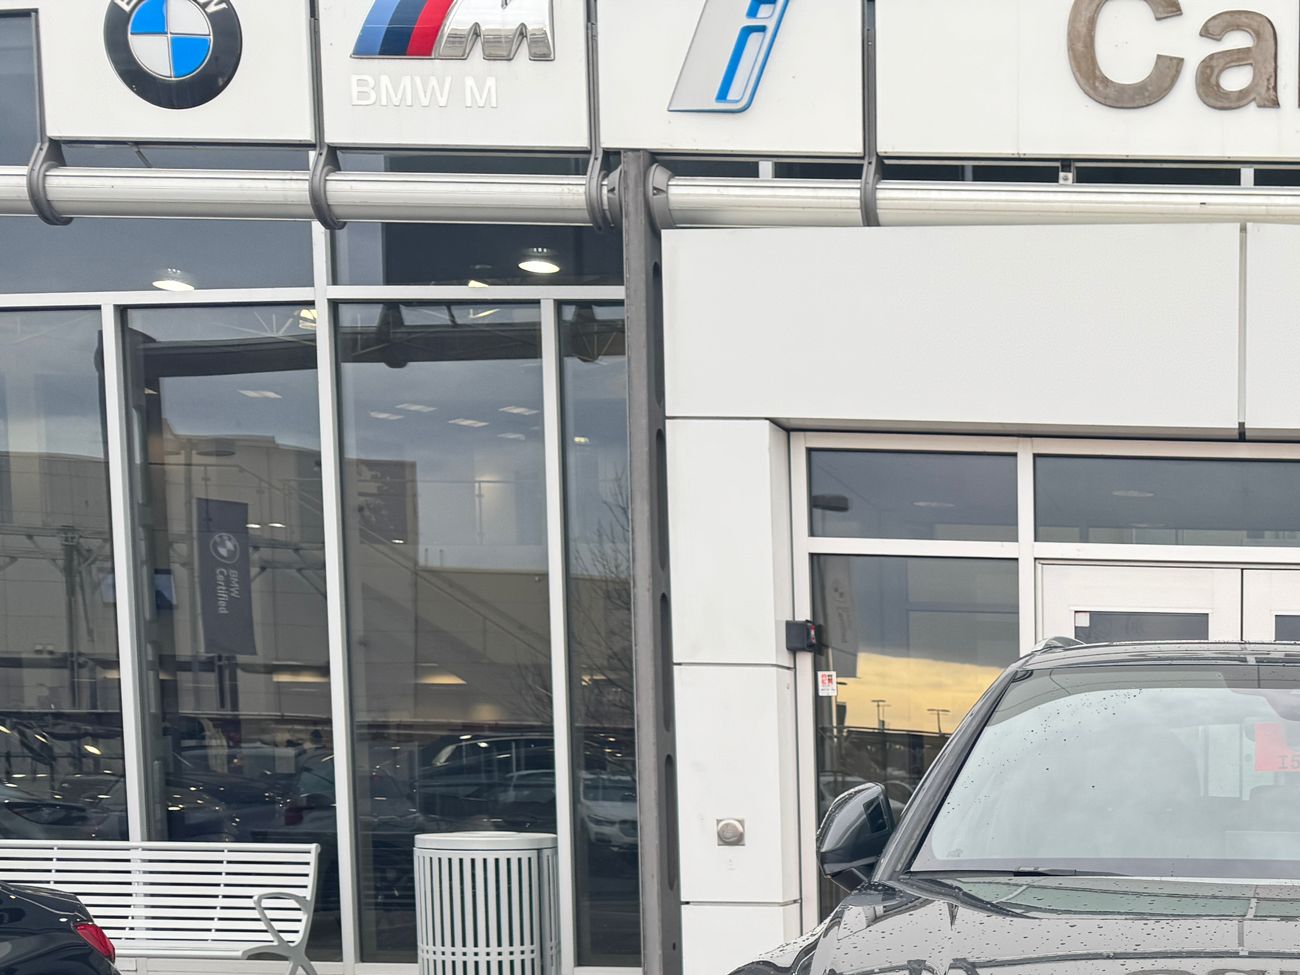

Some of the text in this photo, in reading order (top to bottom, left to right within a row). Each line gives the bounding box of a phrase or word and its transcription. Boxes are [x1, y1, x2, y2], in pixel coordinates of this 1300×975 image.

[351, 74, 498, 109] BMW M
[216, 568, 229, 614] Certified
[228, 569, 241, 598] BMW
